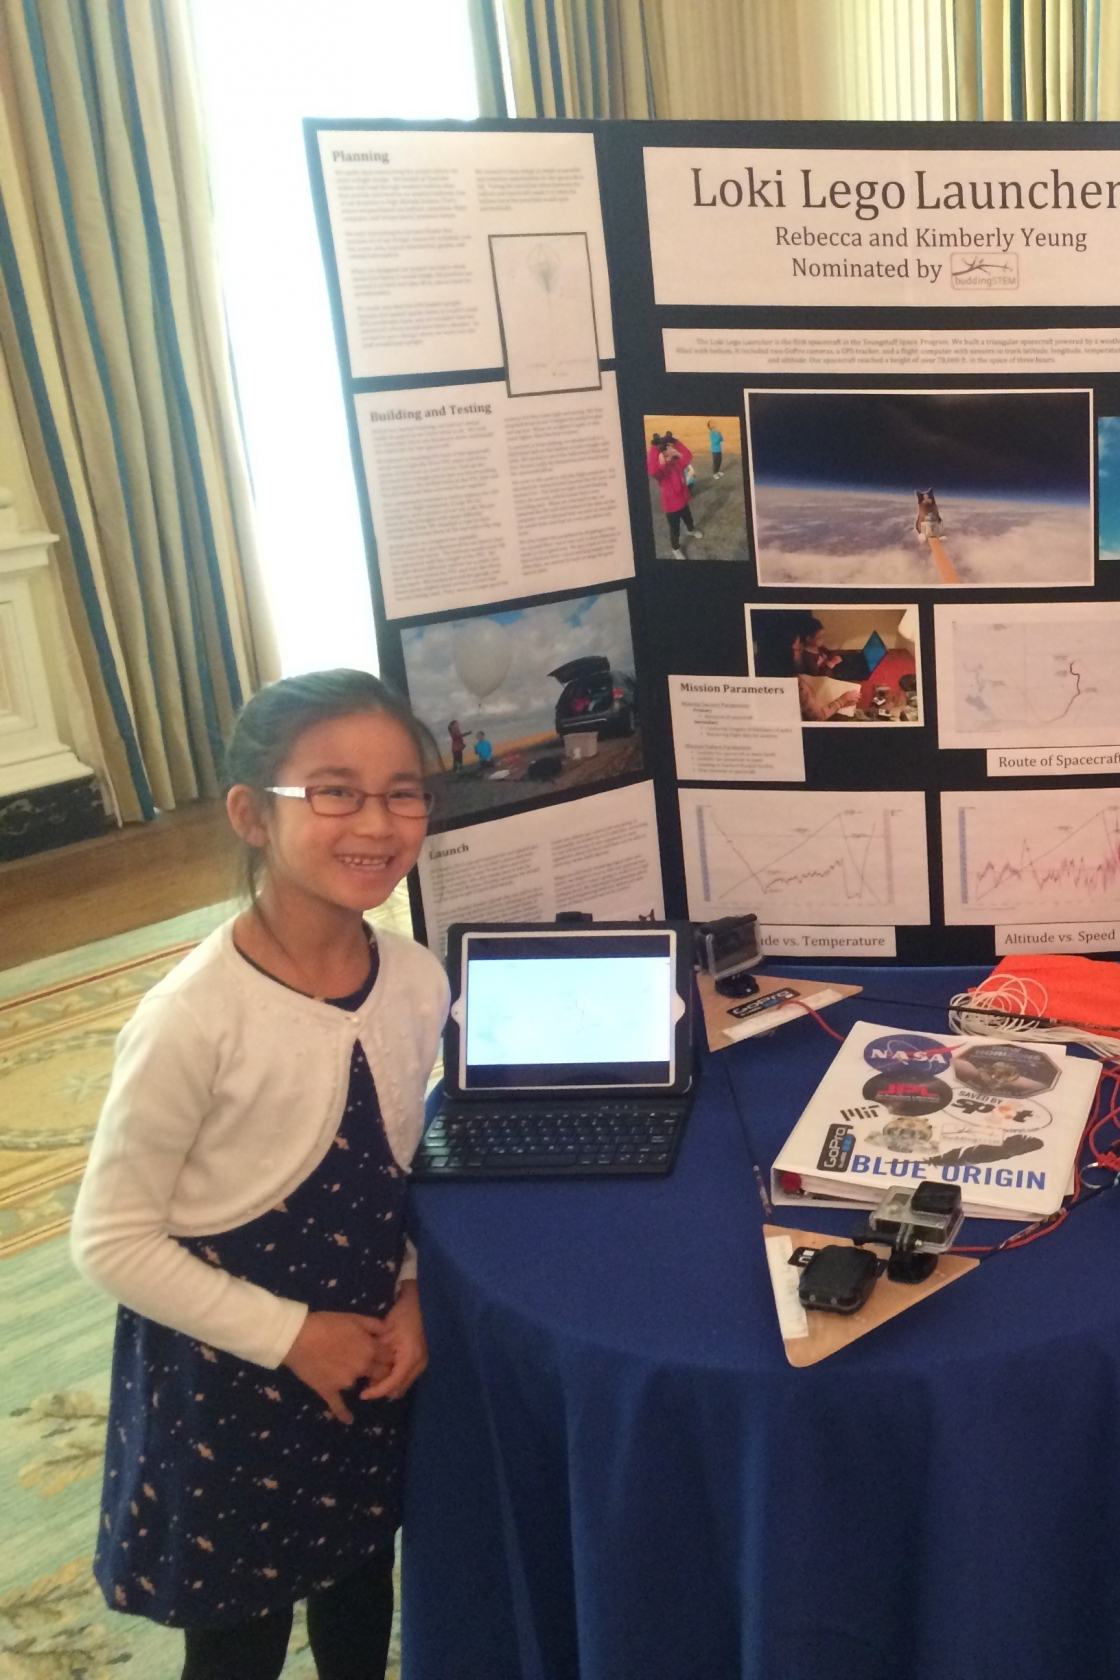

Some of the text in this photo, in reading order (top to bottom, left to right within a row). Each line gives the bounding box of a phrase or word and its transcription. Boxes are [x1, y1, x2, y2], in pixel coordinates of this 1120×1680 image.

[332, 150, 390, 164] Planning
[692, 167, 786, 209] Loki
[800, 169, 905, 220] Lego
[774, 226, 1088, 252] Rebecca and Kimberly Yeung
[791, 257, 943, 283] Nominated by
[953, 275, 1017, 287] buddingSTEM
[370, 402, 493, 423] Building and Testing
[680, 682, 785, 695] Mission Parameters
[998, 755, 1037, 768] Route
[1040, 753, 1054, 767] of
[428, 843, 470, 861] Launch
[784, 935, 800, 946] vs.
[803, 935, 886, 949] Temperature
[1004, 932, 1055, 945] Altitude
[1077, 930, 1116, 948] Speed
[732, 990, 790, 1015] GoPro
[870, 1048, 948, 1064] NASA
[876, 1083, 939, 1098] JPL
[958, 1090, 1004, 1105] SAVED BY
[823, 1127, 847, 1168] GoPro
[851, 1154, 927, 1179] BLUE
[941, 1165, 1046, 1190] ORIGIN
